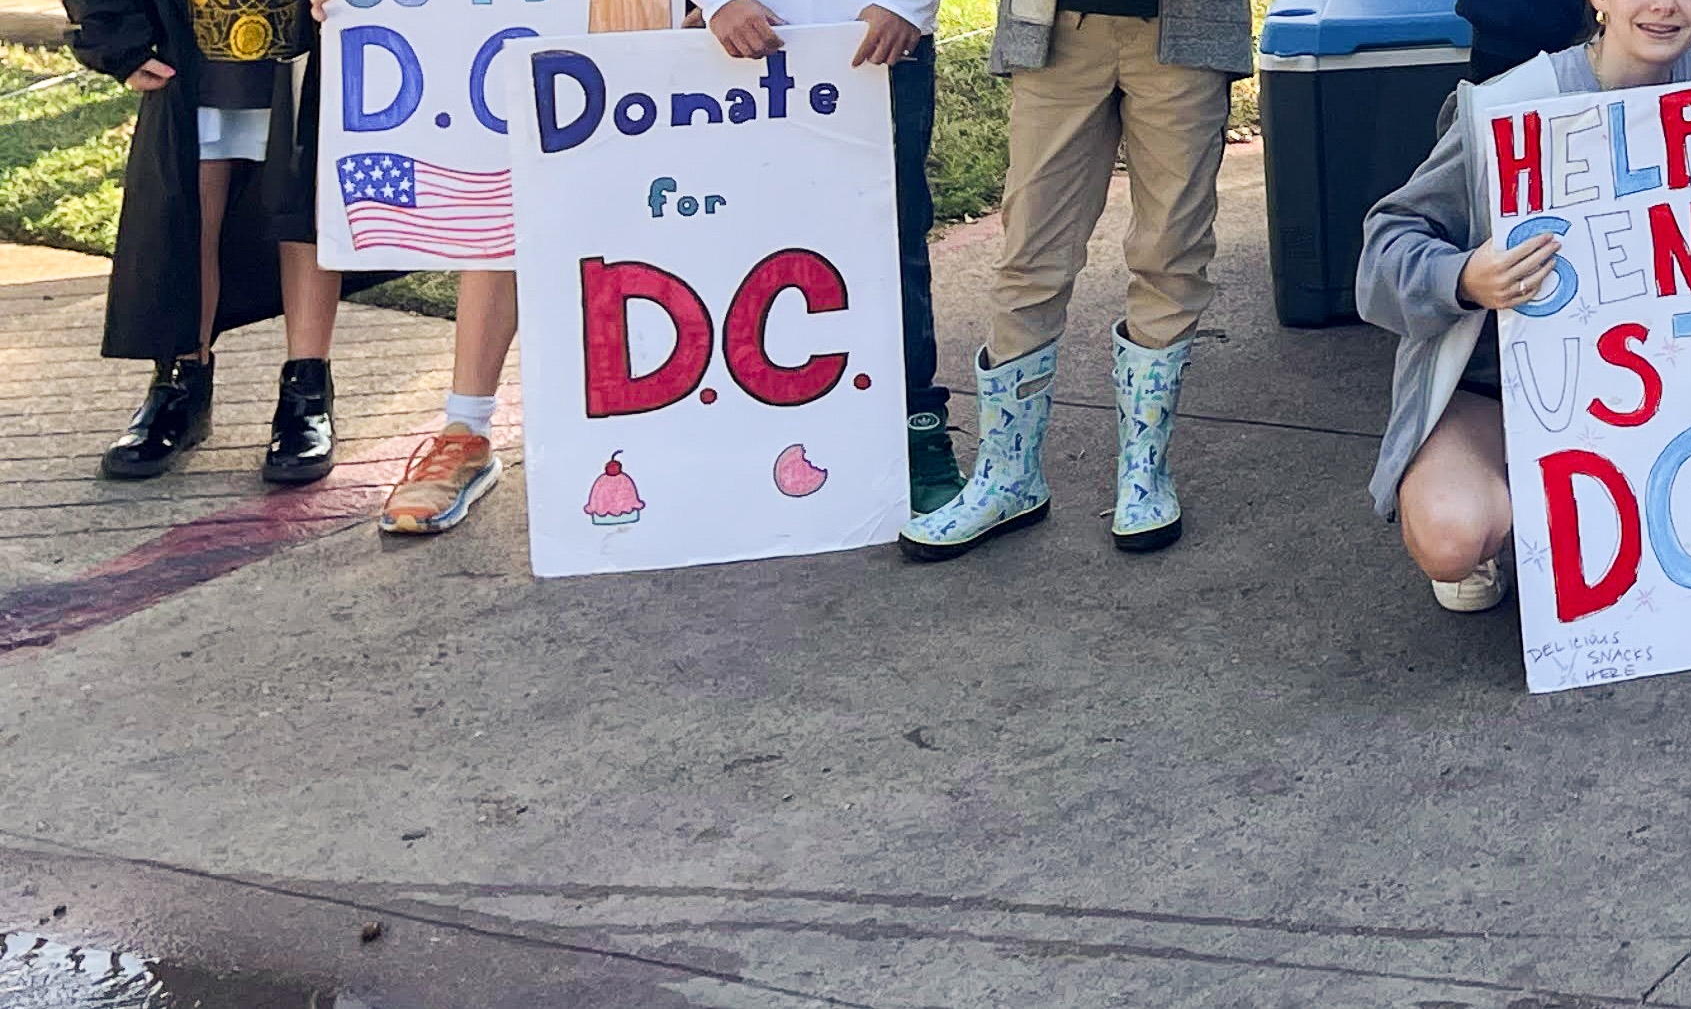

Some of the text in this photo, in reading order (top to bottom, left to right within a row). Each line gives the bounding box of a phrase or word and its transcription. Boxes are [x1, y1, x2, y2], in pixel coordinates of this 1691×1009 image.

[531, 49, 839, 153] Donate
[648, 177, 727, 218] for
[580, 247, 872, 419] D.C.
[1512, 323, 1663, 433] US
[1587, 646, 1654, 665] SNACKS
